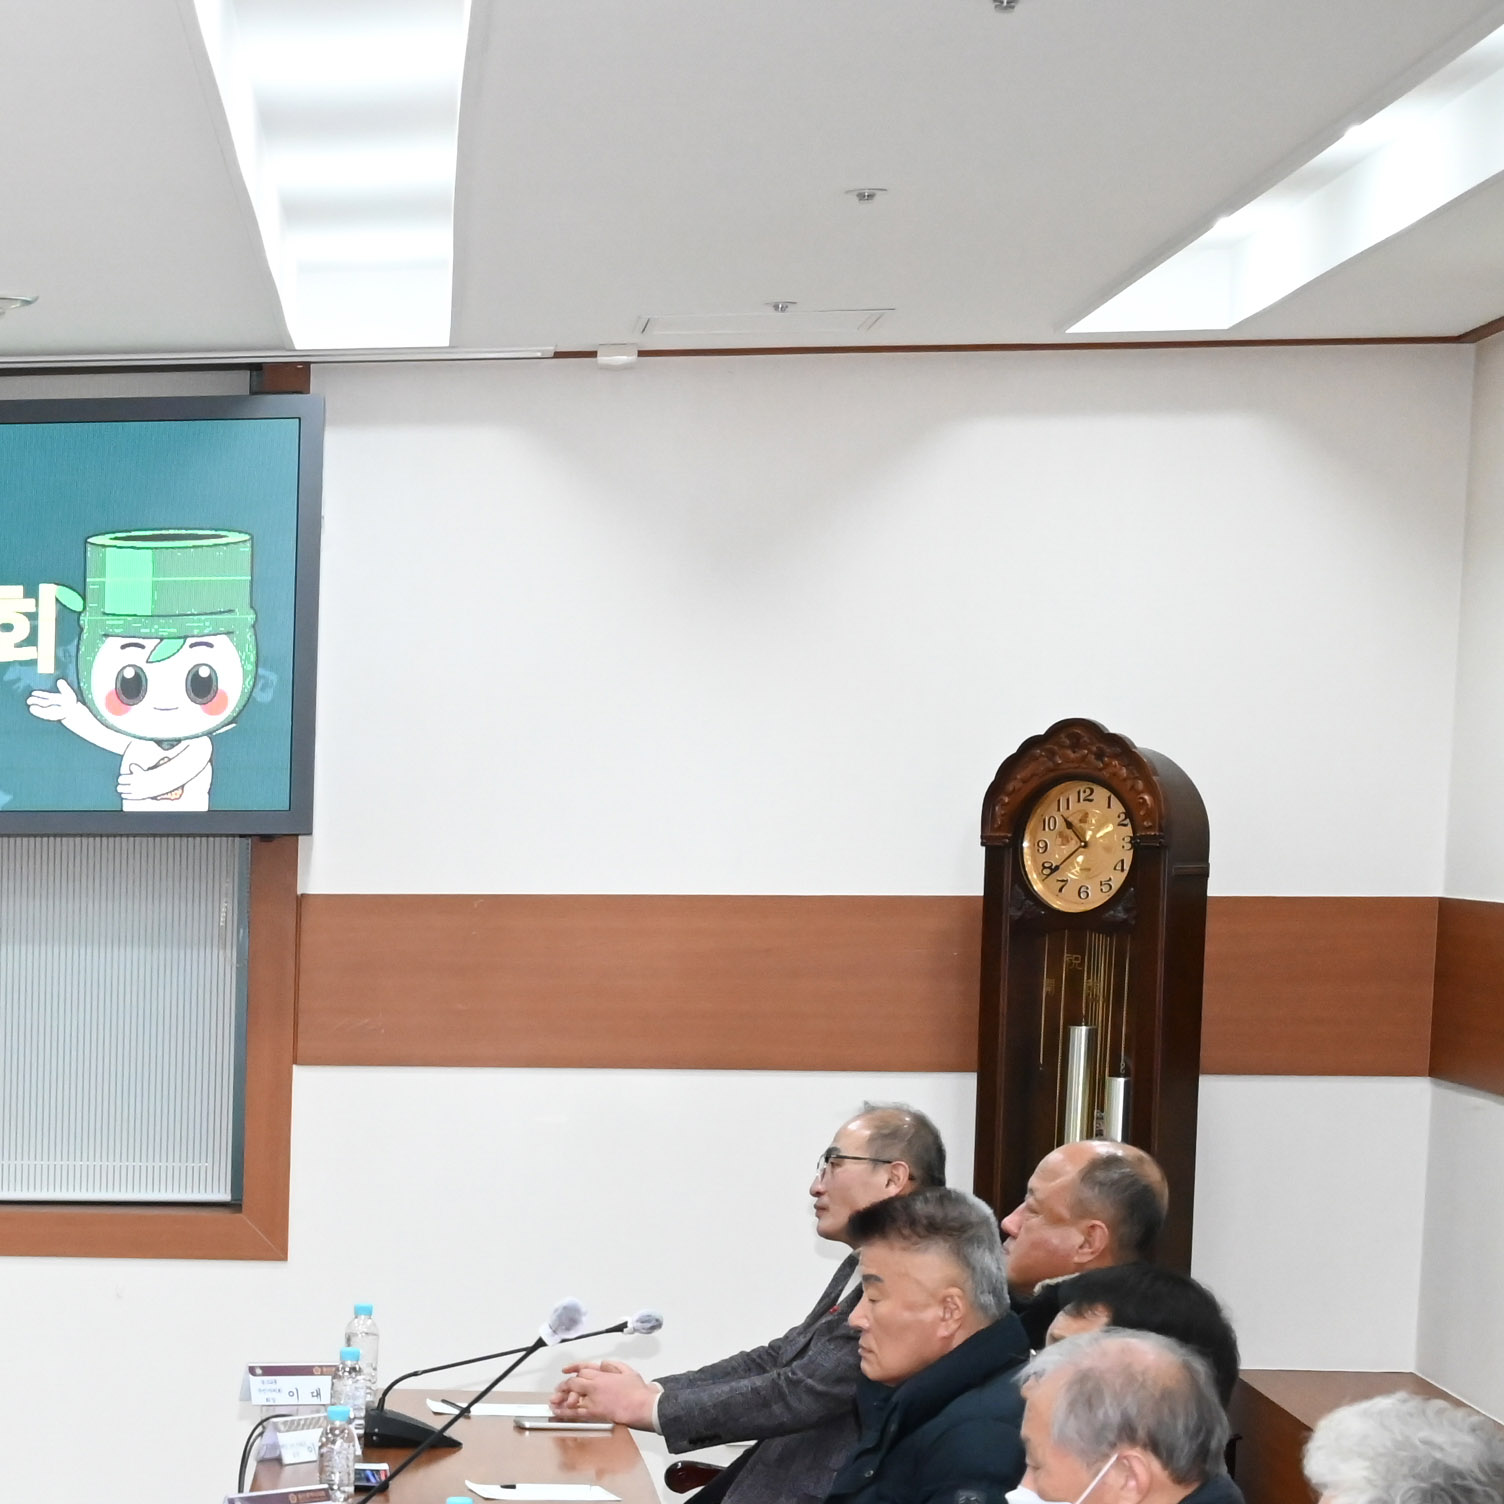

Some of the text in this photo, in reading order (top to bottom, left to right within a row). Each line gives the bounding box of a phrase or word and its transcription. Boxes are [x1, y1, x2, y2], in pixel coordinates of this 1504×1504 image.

[1077, 787, 1094, 803] 12
[1057, 796, 1071, 812] 11
[1042, 816, 1057, 831] 10
[1117, 811, 1129, 827] 2
[1037, 839, 1048, 854] 9
[1122, 835, 1133, 851] 3
[1041, 861, 1054, 876] 8
[1113, 859, 1125, 872] 4
[1056, 879, 1068, 893] 7
[1078, 885, 1089, 900] 6
[1100, 877, 1112, 893] 5
